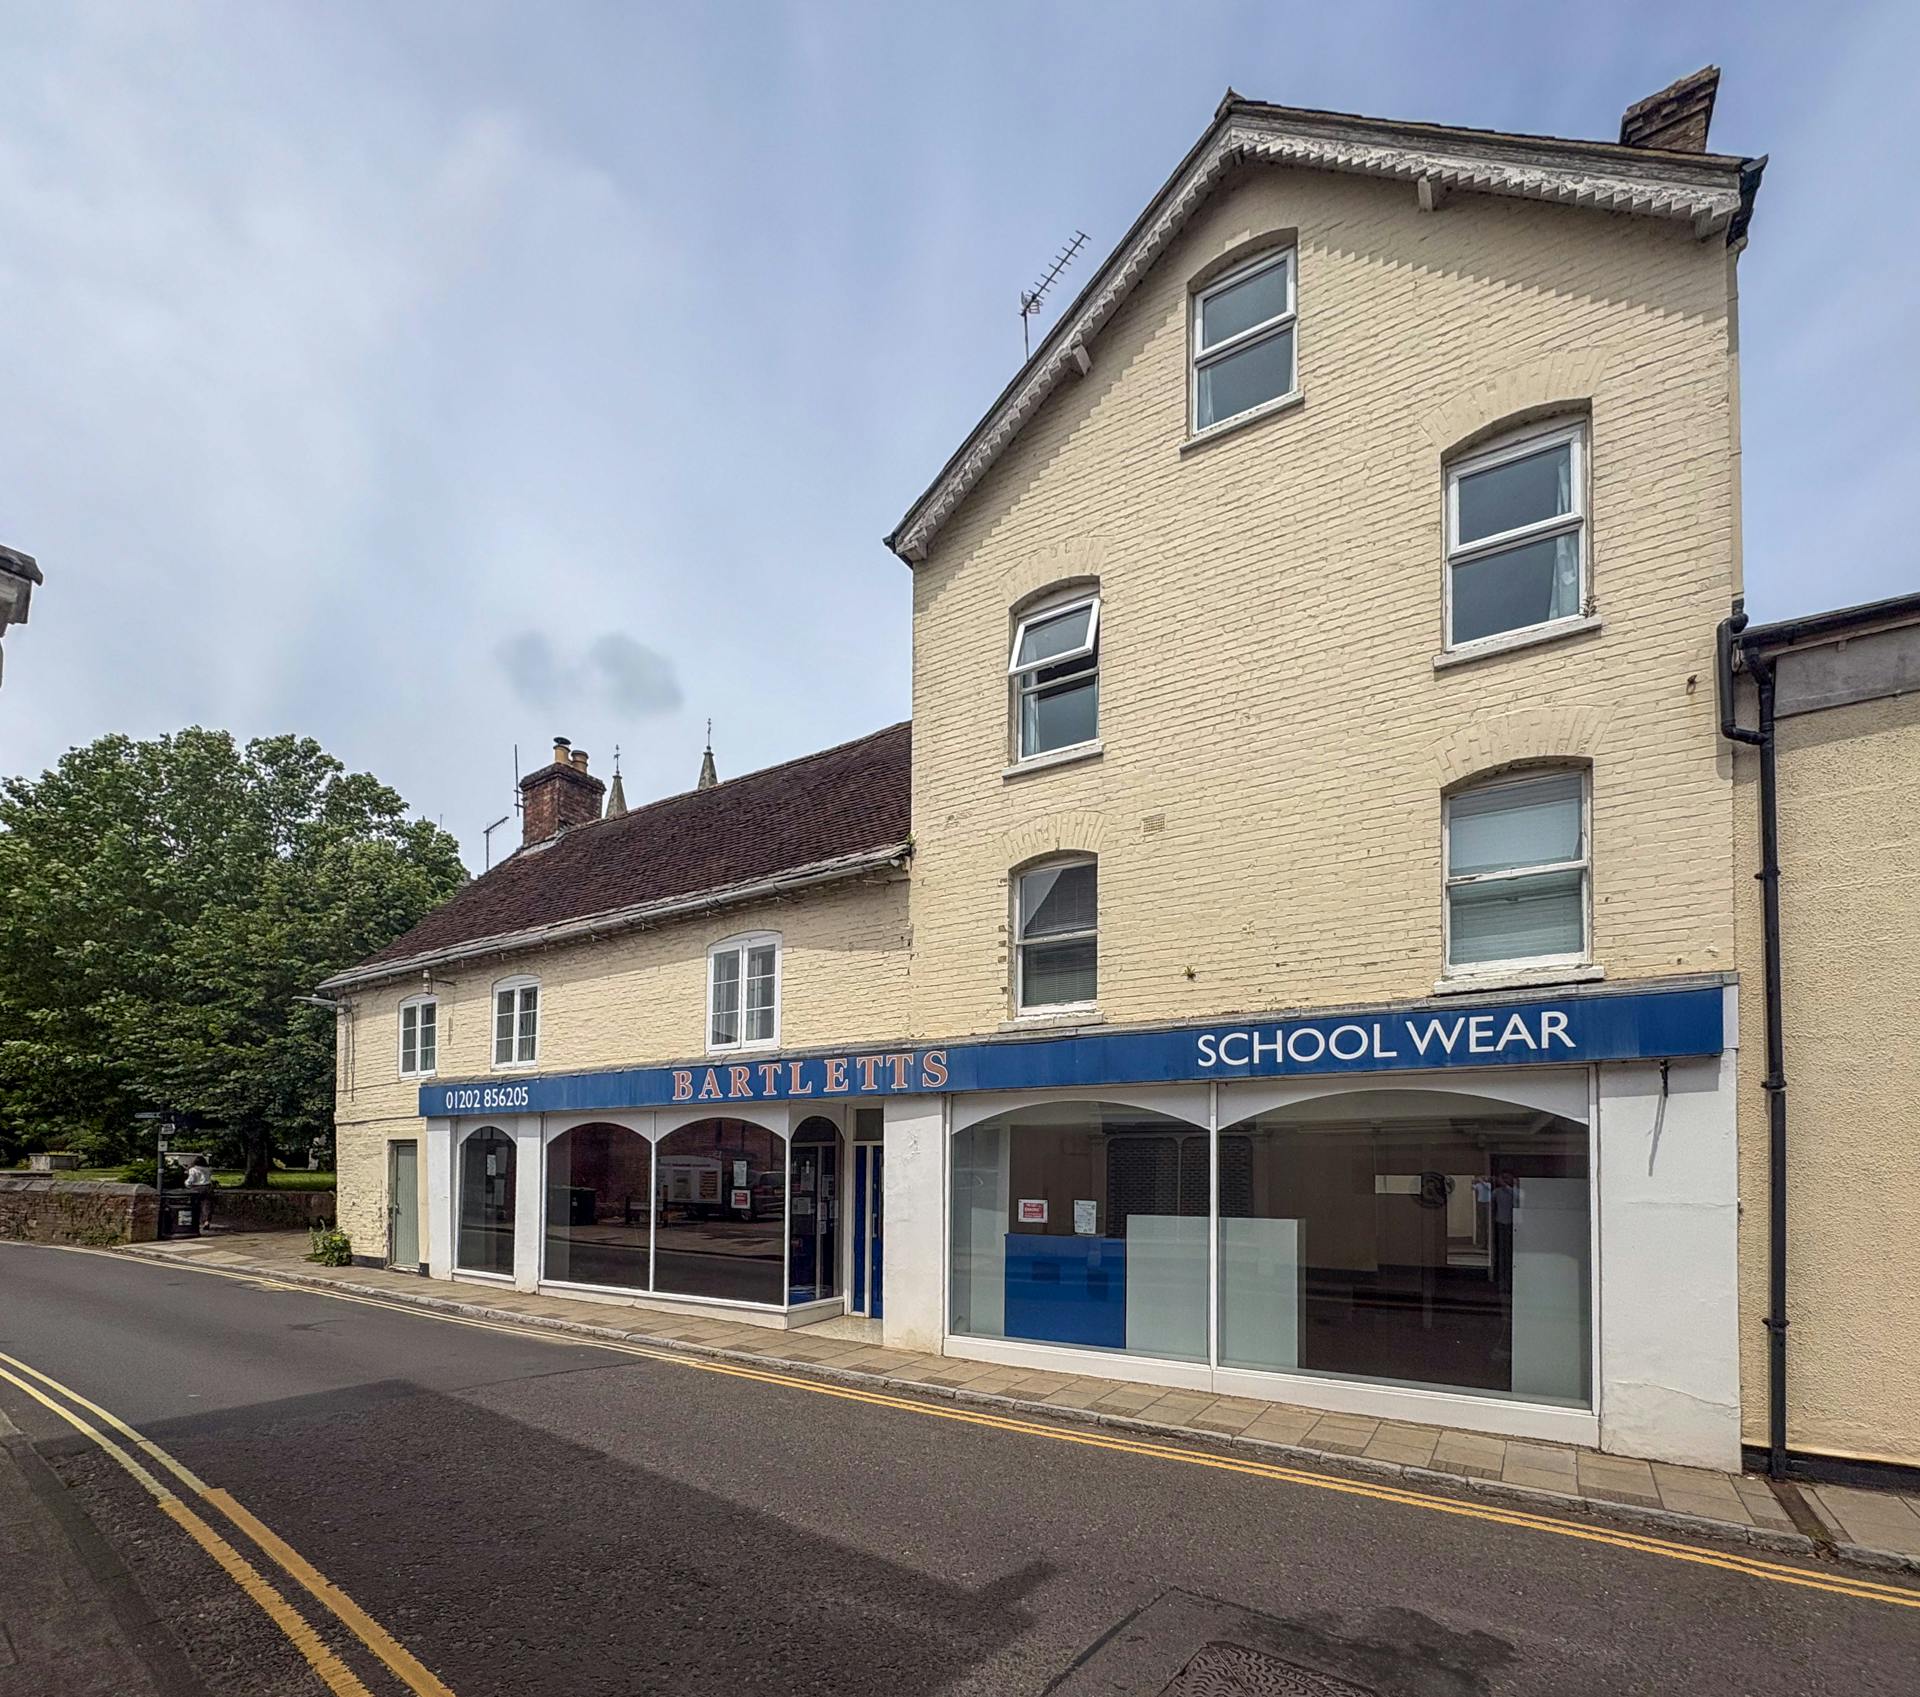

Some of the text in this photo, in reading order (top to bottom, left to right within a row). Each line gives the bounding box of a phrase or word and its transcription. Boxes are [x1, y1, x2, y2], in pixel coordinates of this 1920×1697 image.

[1197, 1011, 1576, 1067] SCHOOL WEAR
[446, 1087, 528, 1109] 01202 856205
[672, 1050, 948, 1100] BARTLETTS
